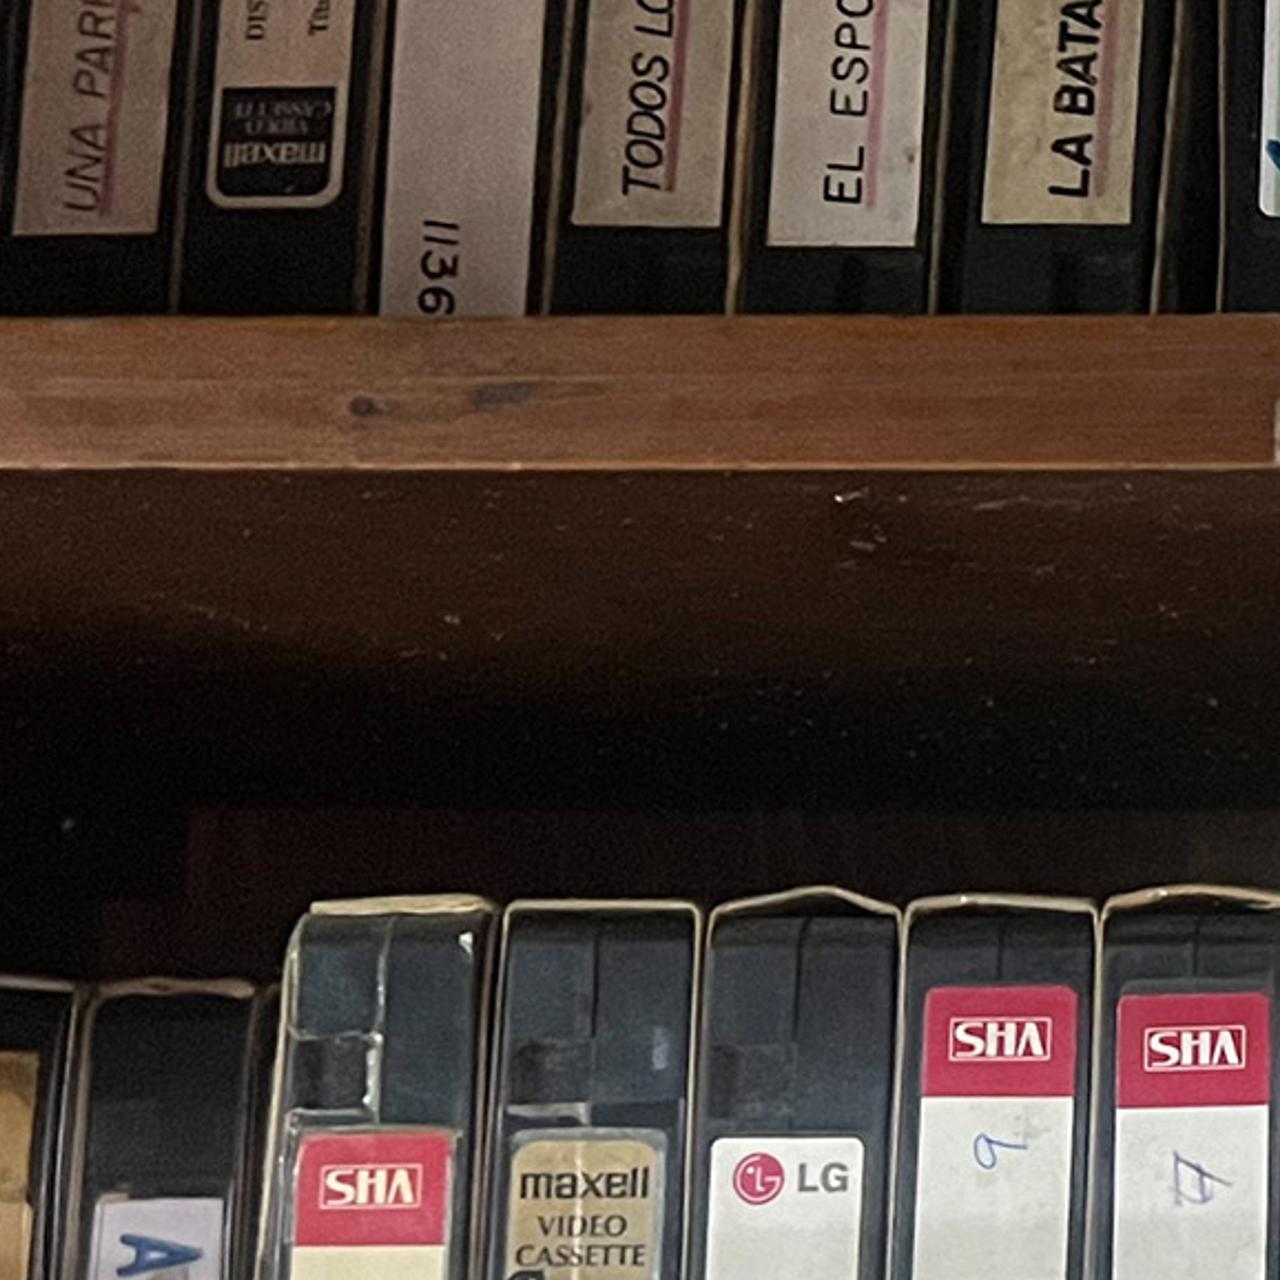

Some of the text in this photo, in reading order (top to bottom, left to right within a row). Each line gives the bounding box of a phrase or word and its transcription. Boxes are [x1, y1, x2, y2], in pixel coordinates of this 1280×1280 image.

[621, 51, 670, 198] TODOS
[64, 125, 108, 215] UNA
[222, 140, 329, 172] maxell
[824, 144, 865, 206] EL
[1047, 133, 1093, 199] LA
[417, 219, 461, 315] 1136
[953, 1021, 1049, 1058] VHS
[1149, 1029, 1242, 1068] VHS
[322, 1168, 418, 1208] VHS
[519, 1167, 650, 1203] maxell
[796, 1162, 850, 1194] LG
[536, 1214, 629, 1238] VIDEO
[515, 1243, 647, 1269] CASSETTE
